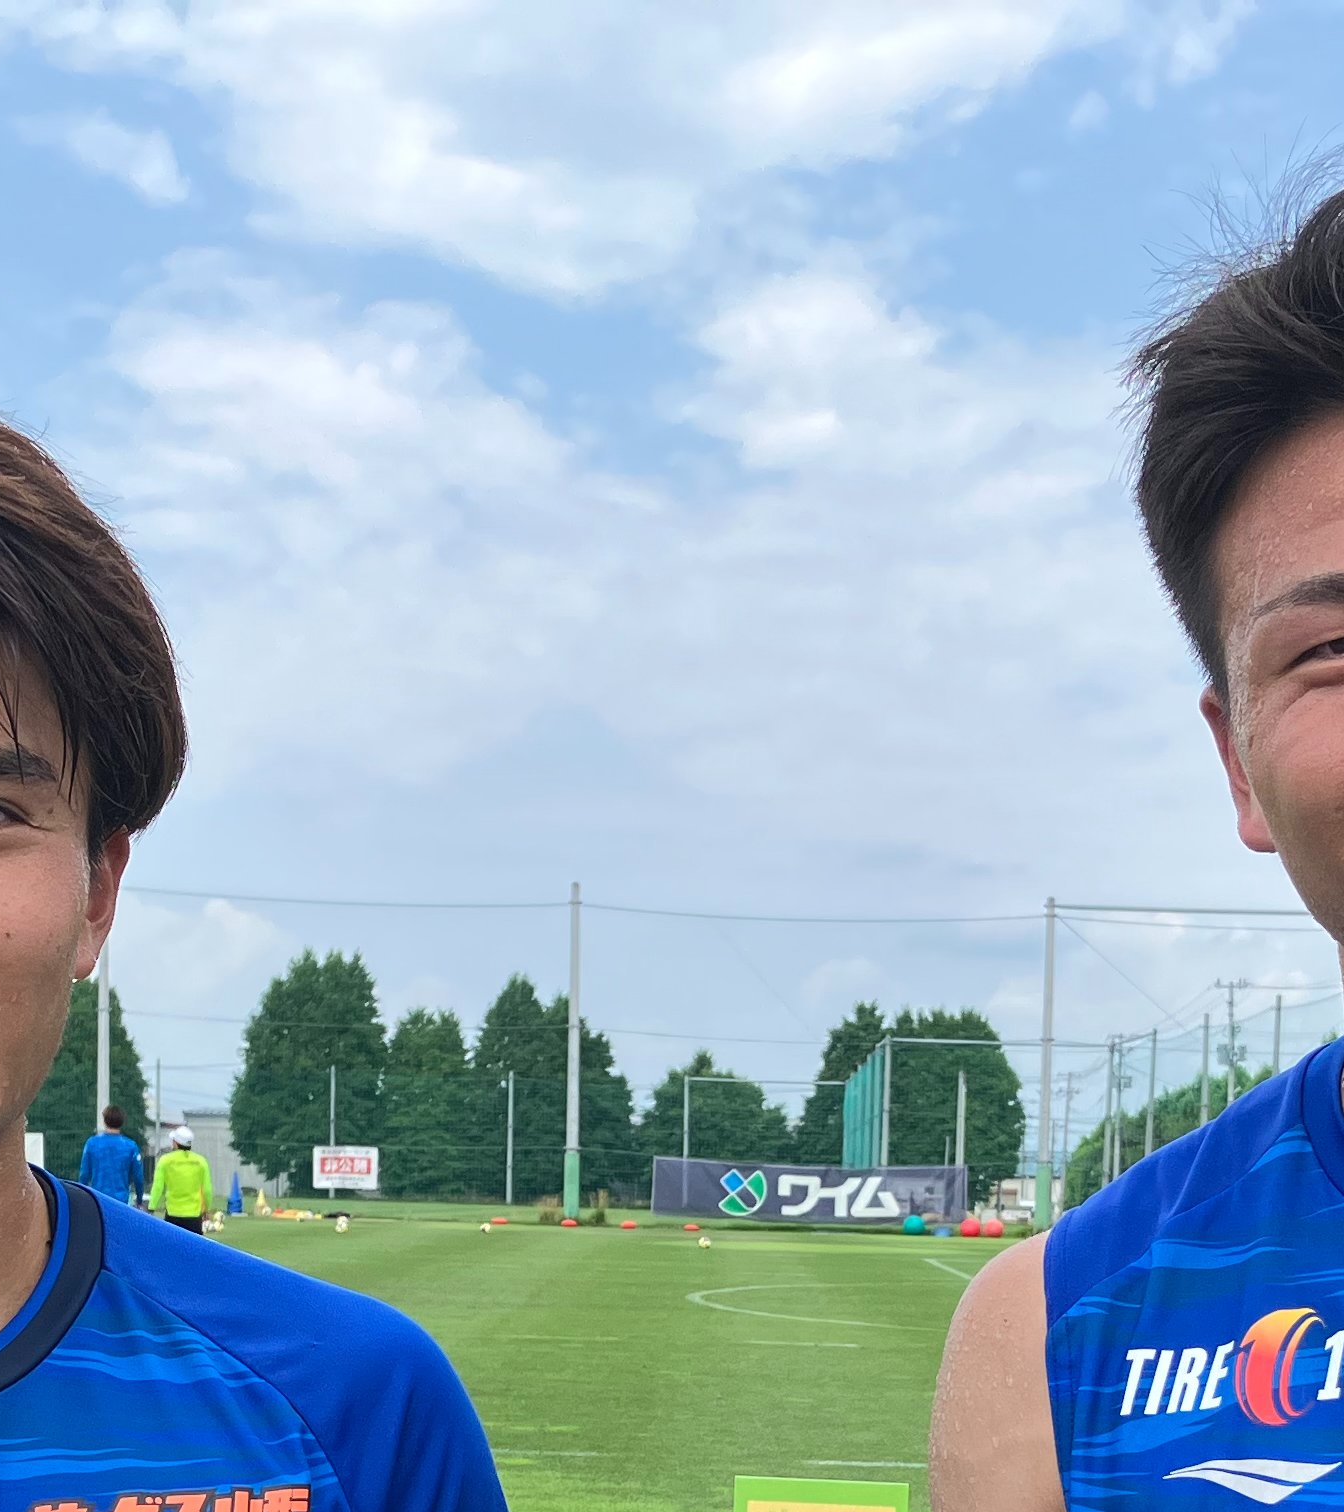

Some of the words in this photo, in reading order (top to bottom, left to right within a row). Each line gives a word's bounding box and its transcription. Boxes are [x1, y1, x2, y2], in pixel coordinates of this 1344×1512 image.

[777, 1174, 901, 1218] ワイム
[1120, 1339, 1235, 1416] TIRE
